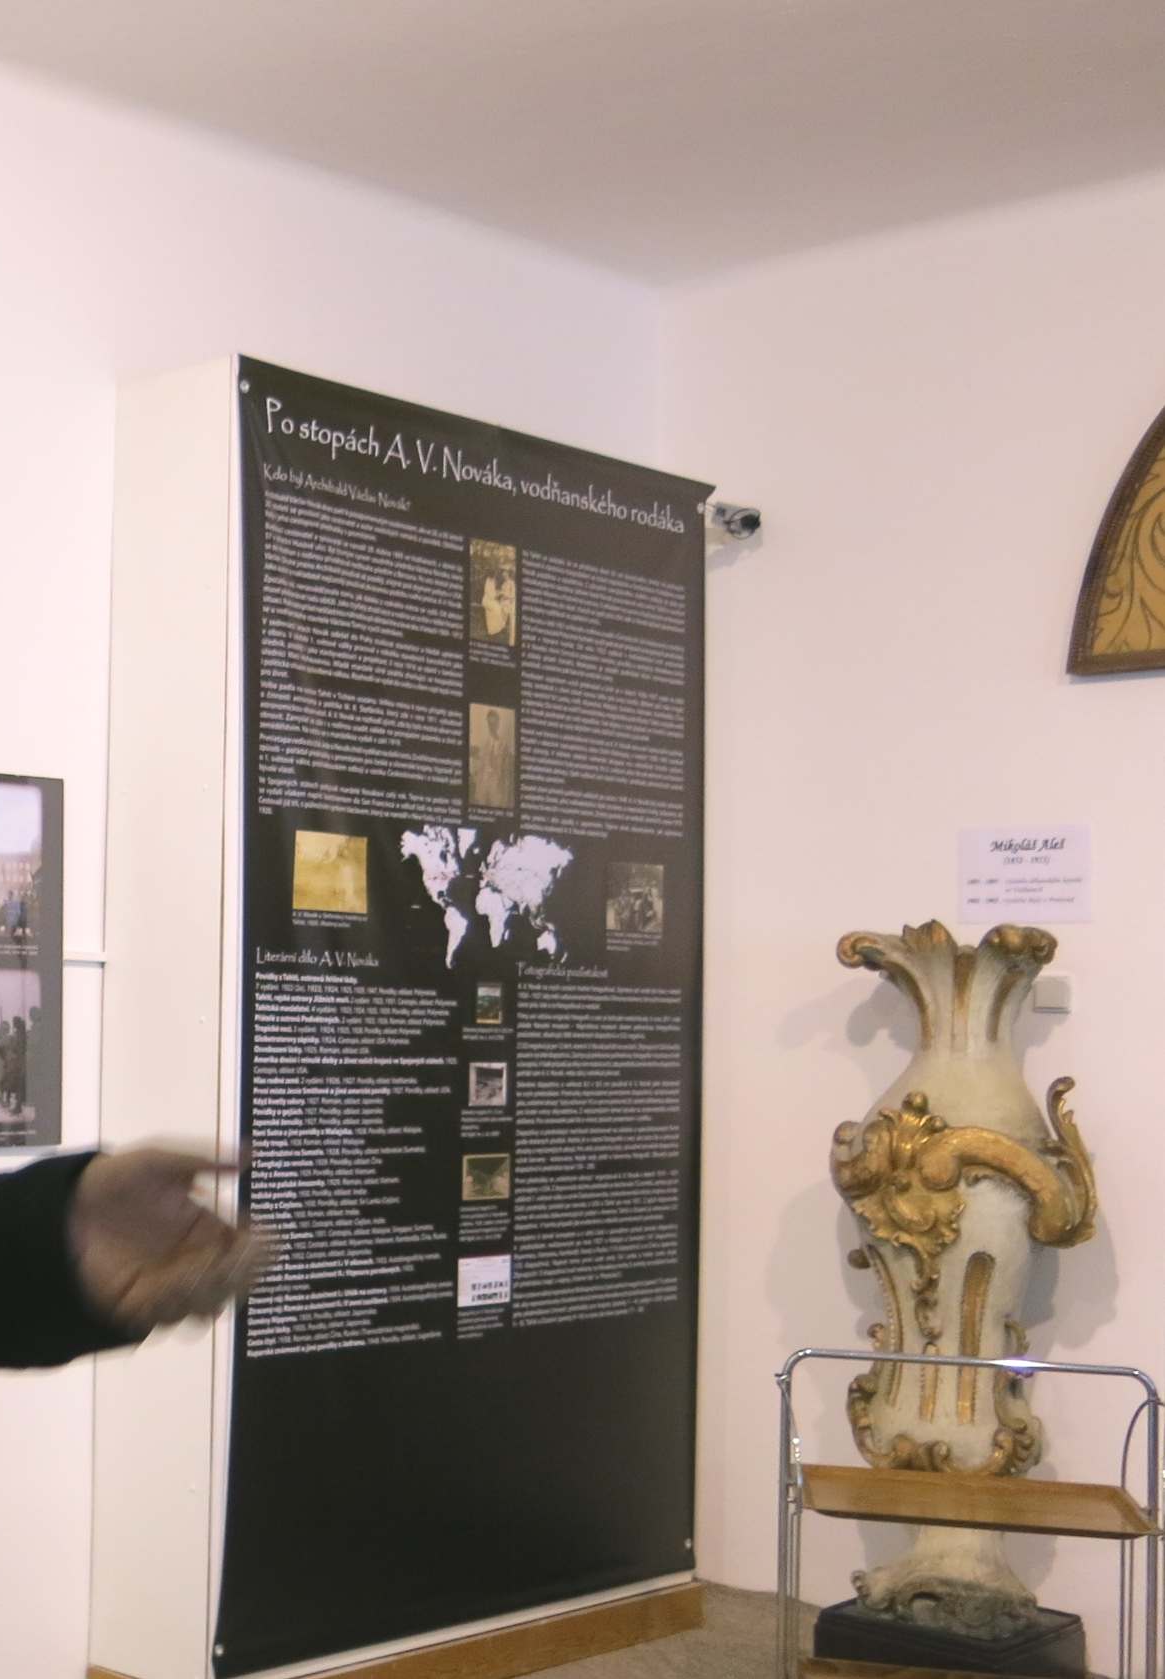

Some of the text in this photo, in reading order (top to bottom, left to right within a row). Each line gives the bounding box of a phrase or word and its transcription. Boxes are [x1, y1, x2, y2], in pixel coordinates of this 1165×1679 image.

[263, 463, 286, 481] Kdo
[265, 397, 684, 534] Po stopách A. V. Nováka, vodňanského rodáka
